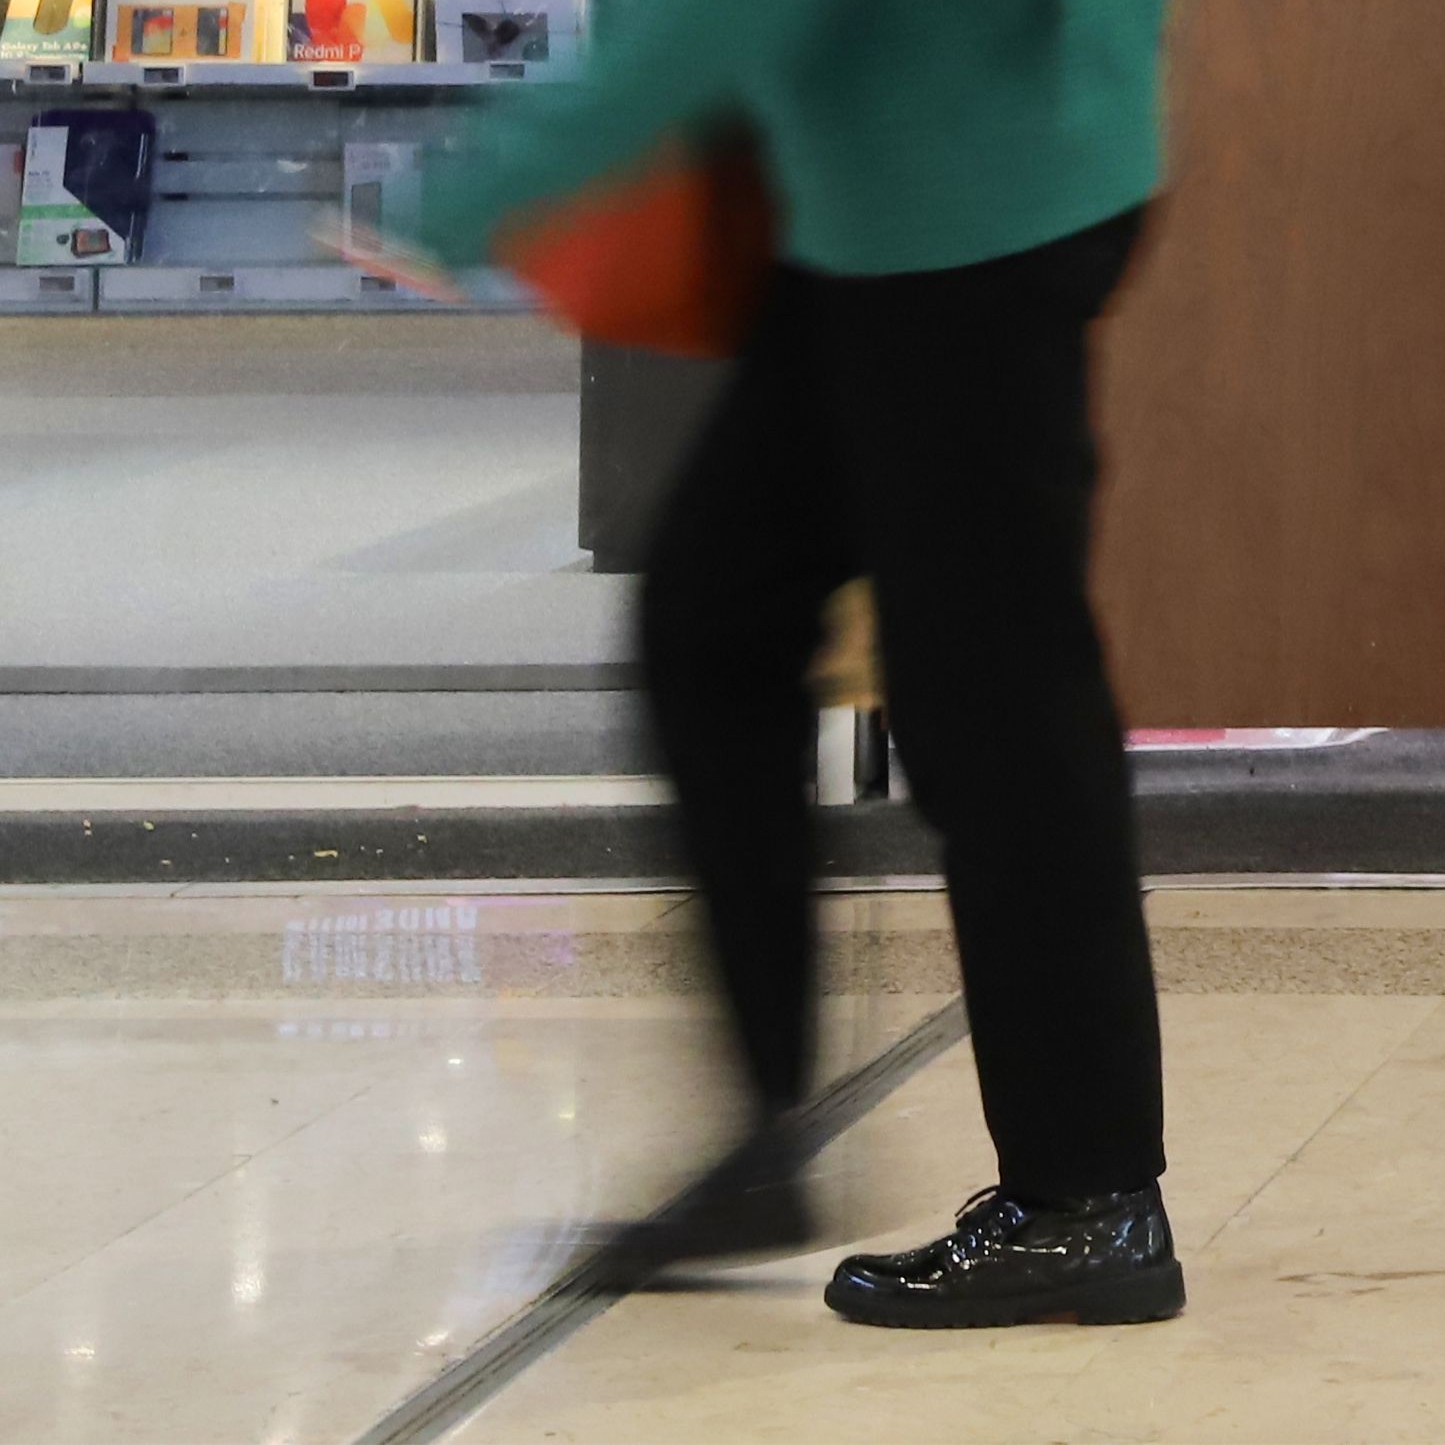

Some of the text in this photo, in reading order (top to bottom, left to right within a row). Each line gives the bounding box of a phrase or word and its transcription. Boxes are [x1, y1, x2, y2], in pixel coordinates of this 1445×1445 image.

[0, 41, 39, 52] Galaxy
[42, 40, 61, 51] Tab
[293, 43, 345, 59] Redmi
